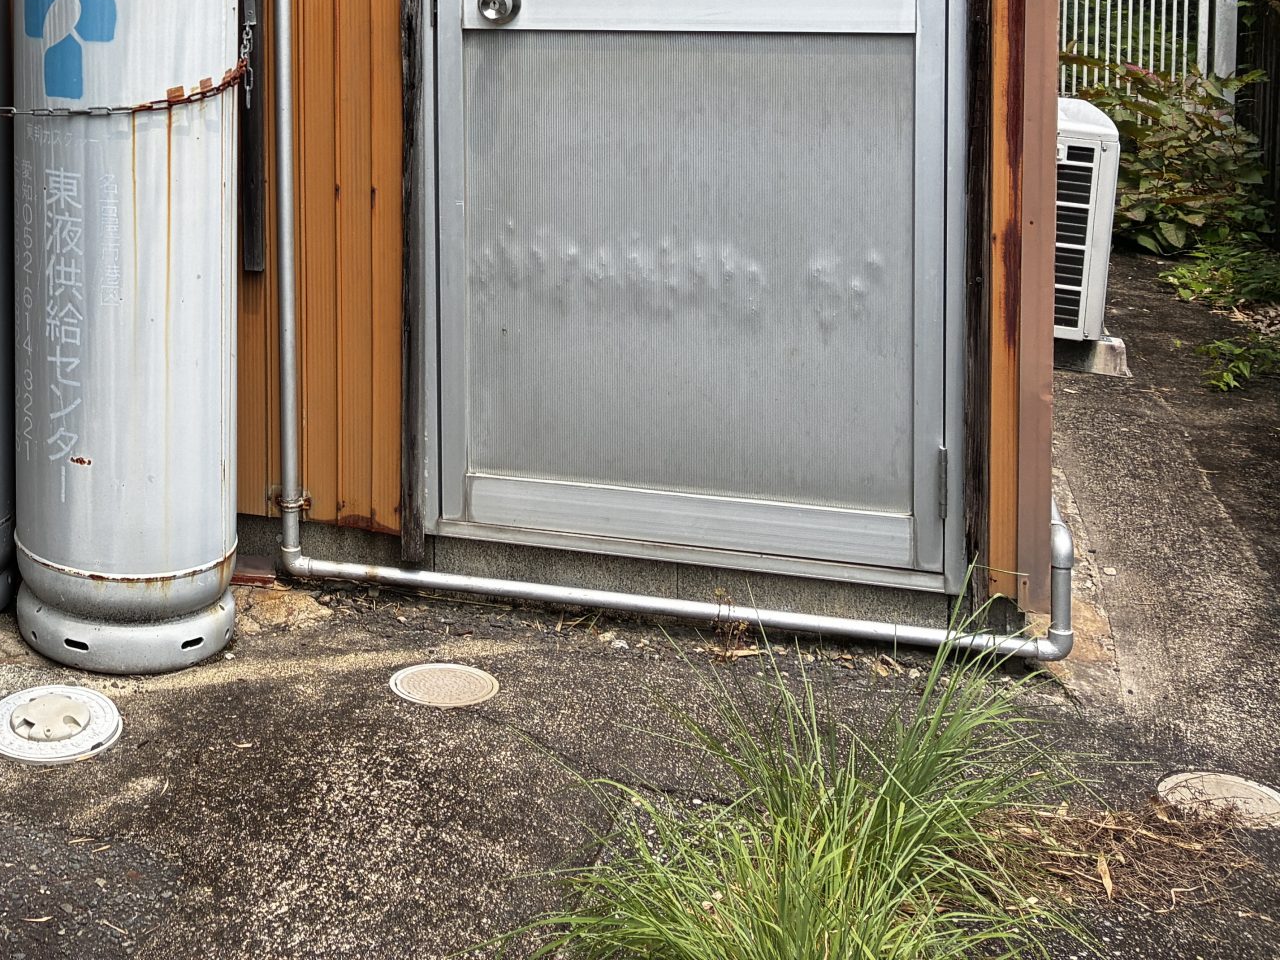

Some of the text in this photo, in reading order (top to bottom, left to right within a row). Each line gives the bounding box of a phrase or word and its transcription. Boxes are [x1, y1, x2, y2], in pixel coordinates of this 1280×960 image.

[45, 167, 84, 503] 東液供給センター
